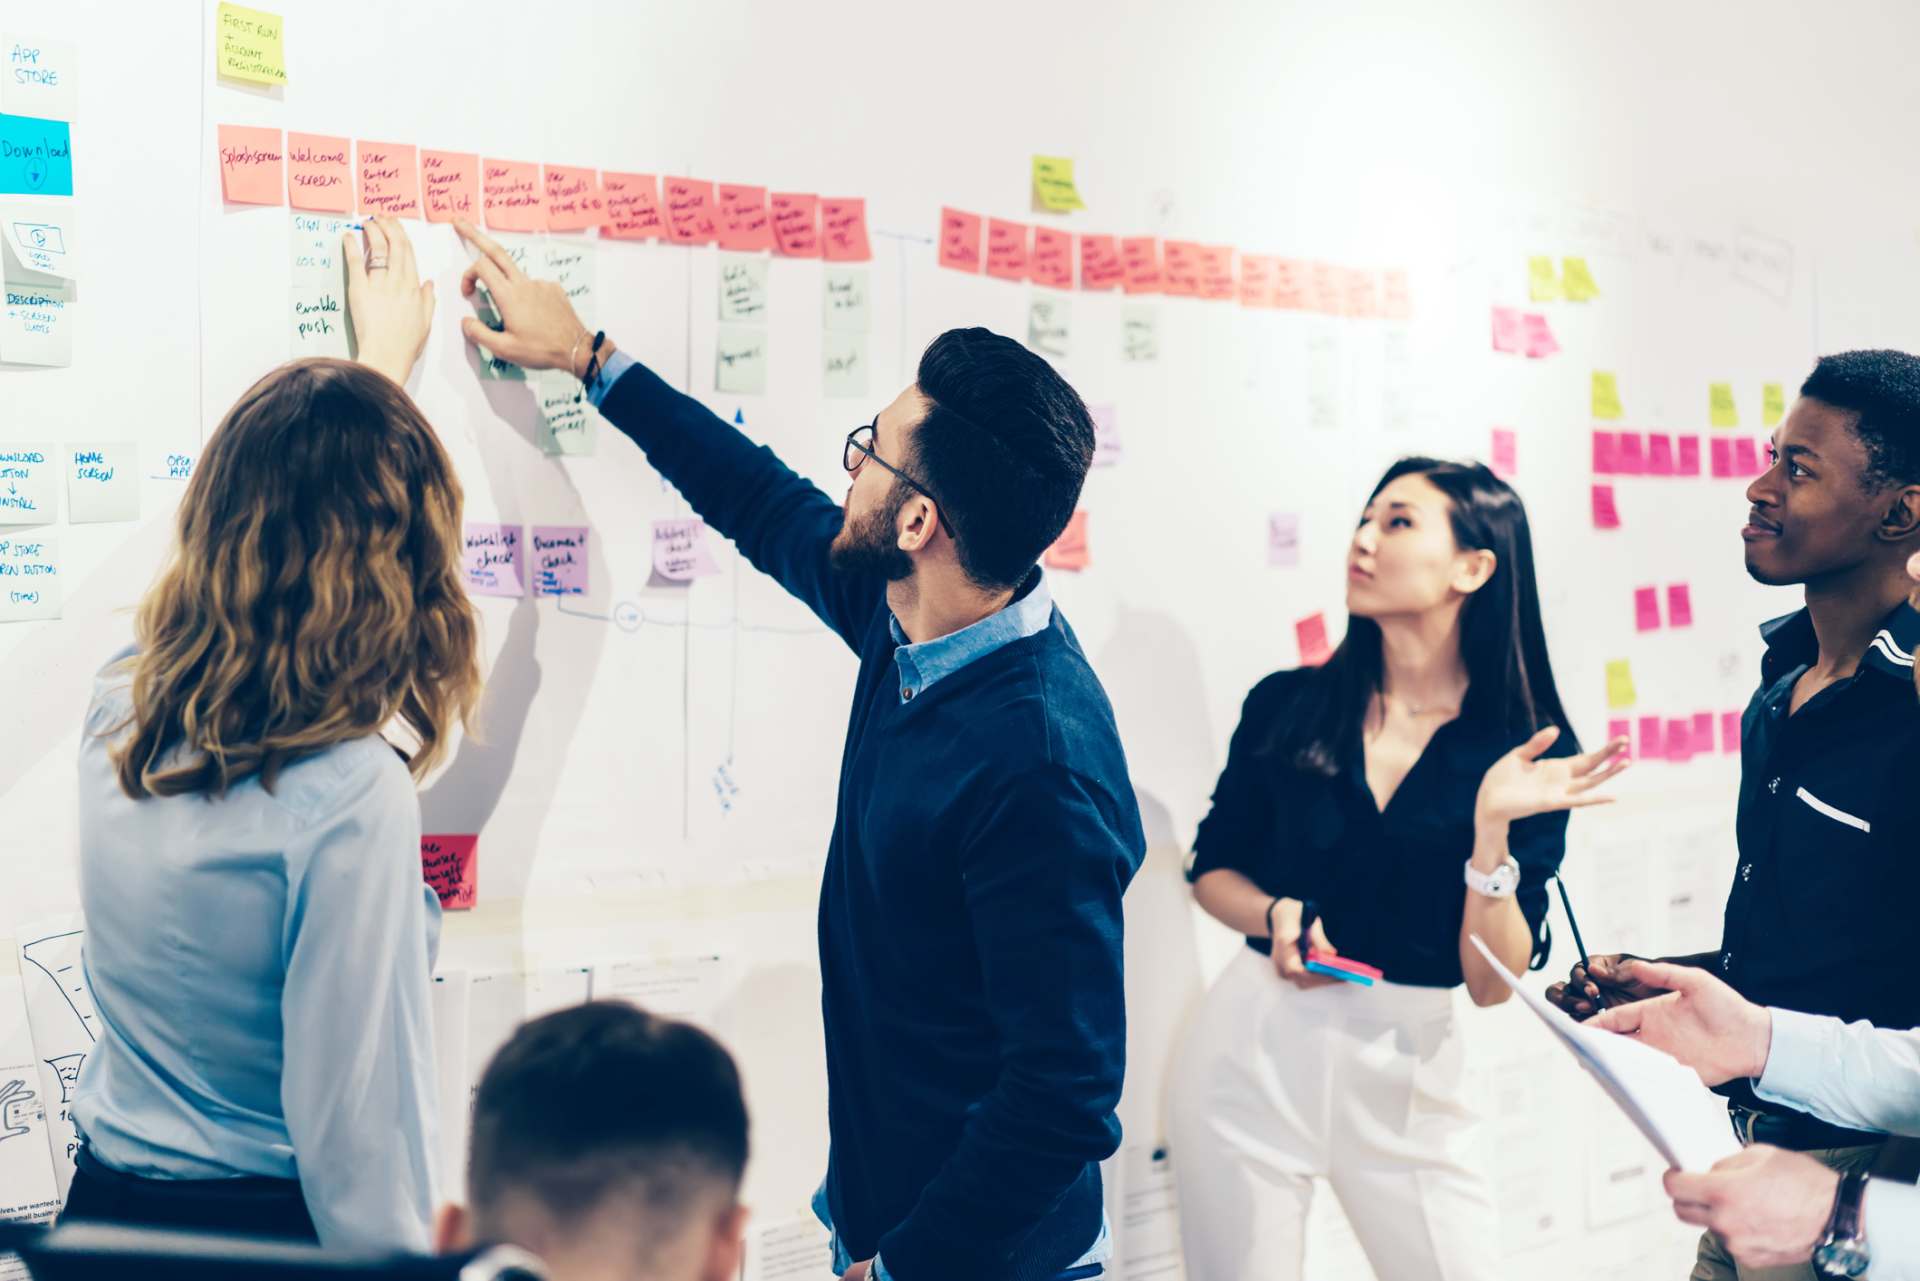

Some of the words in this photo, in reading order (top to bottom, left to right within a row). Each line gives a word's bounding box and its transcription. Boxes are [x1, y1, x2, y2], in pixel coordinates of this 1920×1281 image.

[223, 13, 254, 32] FIRST
[12, 44, 40, 64] APP
[15, 68, 58, 86] STORE
[2, 136, 69, 158] Download
[294, 174, 342, 187] screen
[364, 183, 381, 193] his
[295, 294, 341, 315] enable
[298, 316, 335, 340] push
[74, 451, 104, 465] HOME
[476, 549, 514, 569] check
